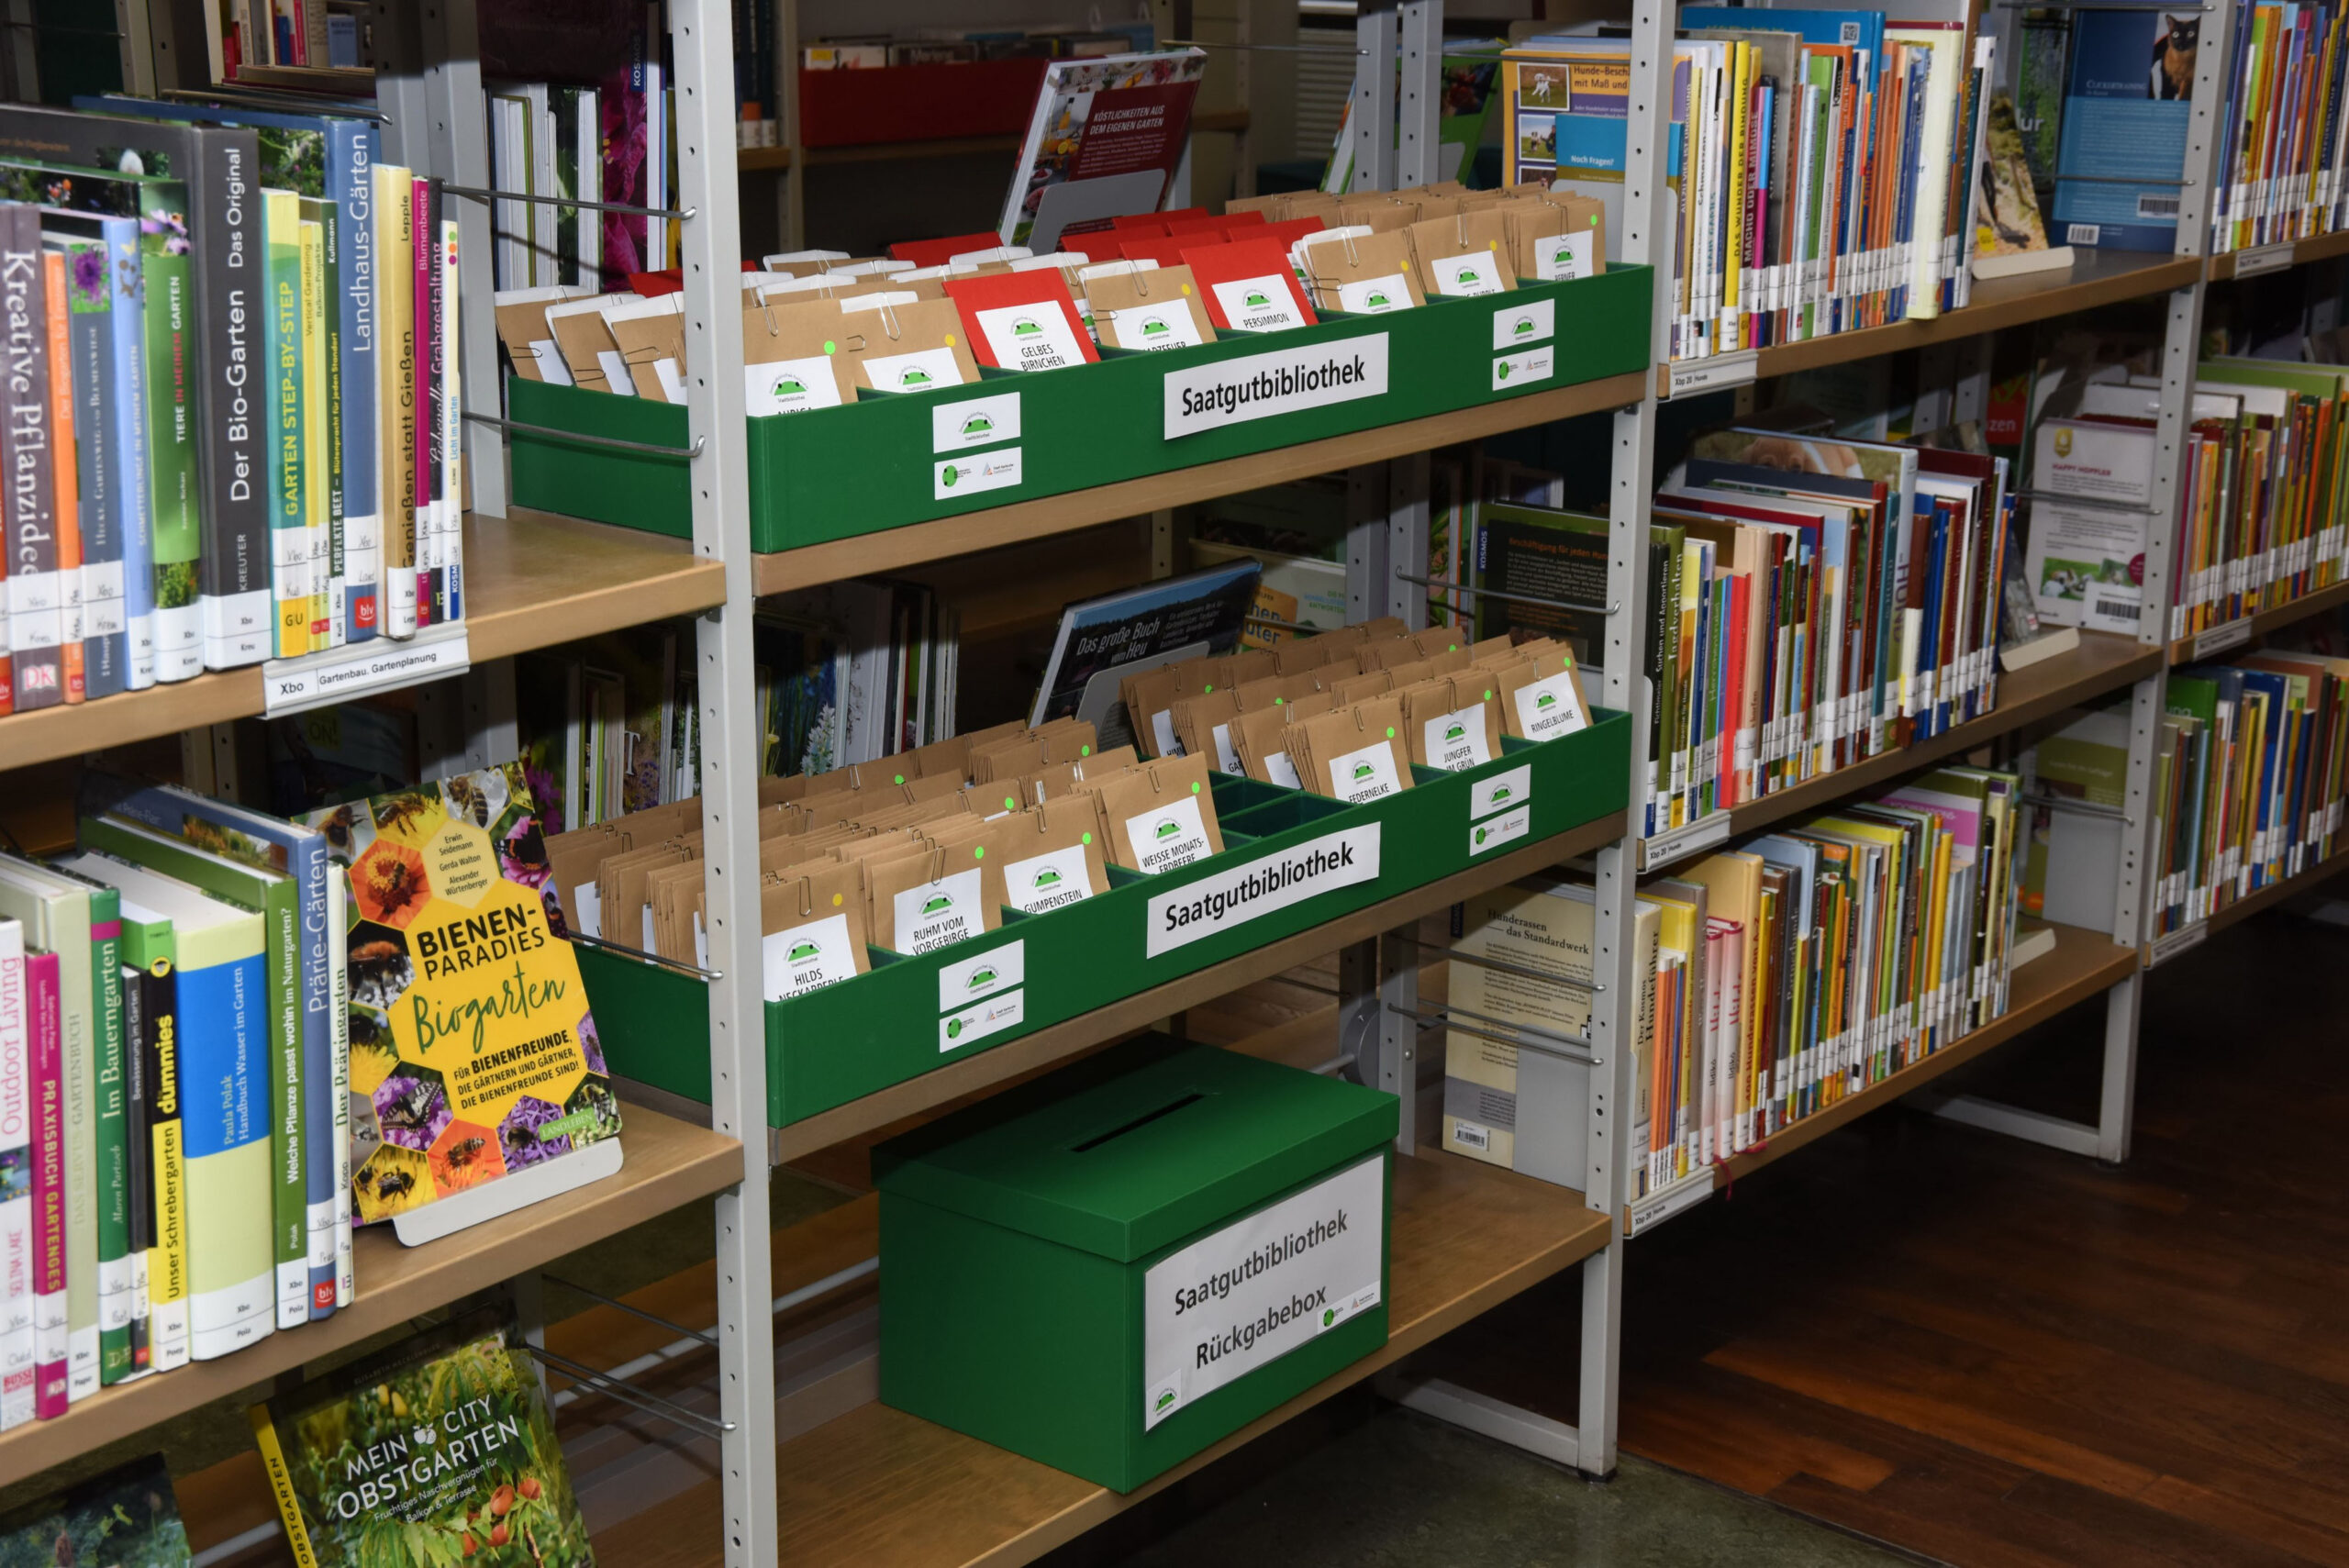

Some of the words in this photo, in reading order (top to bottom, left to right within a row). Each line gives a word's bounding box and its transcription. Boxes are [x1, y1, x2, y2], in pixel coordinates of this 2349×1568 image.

[632, 34, 641, 87] KOSMOS
[1573, 65, 1630, 76] Hunde-Besch
[1574, 80, 1588, 88] mit
[1590, 79, 1609, 89] Maß
[1612, 81, 1628, 90] und
[1089, 124, 1107, 136] DEM
[1106, 121, 1137, 133] EIGENEN
[1136, 117, 1164, 130] GARTEN
[1093, 106, 1150, 123] KÖSTLICHKEITEN
[1150, 105, 1165, 116] AUS
[1571, 154, 1588, 164] Noch
[1588, 156, 1615, 167] Fragen?
[1748, 111, 1759, 168] MIMOSE
[226, 148, 246, 226] Original
[1735, 172, 1744, 228] WUNDER
[1746, 172, 1756, 208] ODER
[401, 195, 410, 241] Lepple
[418, 189, 428, 272] Blumenbeete
[1743, 212, 1754, 262] MACHO
[229, 231, 244, 268] Das
[328, 217, 336, 264] Kullmann
[350, 134, 371, 352] Landhaus-Gärten
[1733, 232, 1742, 257] DAS
[305, 243, 313, 296] Gardening
[3, 249, 40, 395] Kreative
[172, 276, 182, 330] GARTEN
[305, 298, 313, 337] Vertical
[1242, 312, 1290, 330] PERSIMMON
[173, 332, 183, 387] MEINEM
[227, 290, 250, 441] Bio-Garten
[279, 281, 296, 428] STEP-BY-STEP
[400, 329, 412, 408] Gießen
[1020, 355, 1066, 372] BIRNCHEN
[1021, 343, 1054, 358] GELBES
[174, 387, 183, 404] IN
[1182, 354, 1365, 417] Saatgutbibliothek
[176, 405, 186, 443] TIERE
[402, 415, 414, 459] statt
[230, 450, 250, 501] Der
[284, 433, 297, 516] GARTEN
[239, 533, 249, 592] KREUTER
[1479, 529, 1487, 570] KOSMOS
[1075, 637, 1097, 657] Das
[1097, 625, 1131, 653] große
[1131, 617, 1161, 639] Buch
[1657, 617, 1665, 637] und
[280, 682, 304, 695] Xbo
[371, 651, 437, 675] Gartenplanung
[1110, 652, 1127, 665] vom
[1126, 641, 1147, 660] Heu
[1655, 639, 1665, 673] Suchen
[25, 664, 56, 691] DK
[1531, 709, 1575, 734] RINGELBLUME
[1443, 745, 1473, 764] JUNGFER
[1348, 783, 1390, 805] FEDERNELKE
[439, 840, 473, 857] Seidemann
[444, 832, 463, 844] Erwin
[1141, 849, 1170, 868] WEISSE
[1171, 839, 1205, 858] MONATS-
[439, 861, 459, 873] Gerda
[458, 854, 482, 866] Walton
[449, 870, 480, 885] Alexander
[445, 878, 488, 896] Würtenberger
[1023, 889, 1083, 914] GUMPENSTEIN
[1165, 840, 1354, 932] Saatgutbibliothek
[306, 848, 328, 1013] Prärie-Gärten
[417, 903, 538, 960] BIENEN-
[912, 928, 970, 956] VORGEBIRGE
[913, 922, 941, 942] RUHM
[941, 916, 964, 934] VOM
[1487, 908, 1548, 932] Hunderassen
[1506, 926, 1521, 938] das
[1523, 930, 1589, 955] Standardwerk
[281, 907, 296, 986] Naturgarten?
[424, 926, 546, 982] PARADIES
[0, 955, 23, 1033] Living
[233, 967, 244, 1014] Garten
[283, 988, 295, 1005] im
[794, 968, 823, 986] HILDS
[1645, 930, 1660, 1041] Hundeführer
[100, 940, 122, 1085] Bauerngarten
[234, 1014, 245, 1030] im
[412, 961, 566, 1055] Biogarten
[1638, 979, 1648, 1022] Kosmos
[284, 1006, 296, 1046] wohin
[334, 968, 348, 1085] Präriegarten
[1637, 1023, 1645, 1046] Der
[1745, 977, 1757, 1081] Hunderassen
[156, 1013, 177, 1115] dummies
[235, 1034, 246, 1073] Wasser
[285, 1048, 299, 1084] passt
[453, 1067, 471, 1081] FÜR
[471, 1029, 573, 1074] BIENENFREUNDE,
[457, 1084, 473, 1096] DIE
[473, 1067, 518, 1091] GÄRTNERN
[519, 1061, 537, 1075] UND
[538, 1047, 577, 1068] GÄRTNER,
[1, 1038, 23, 1136] Outdoor
[103, 1088, 121, 1118] Im
[221, 1075, 233, 1109] Polak
[236, 1074, 249, 1140] Handbuch
[461, 1097, 477, 1110] DIE
[479, 1069, 554, 1104] BIENENFREUNDE
[555, 1061, 580, 1078] SIND!
[223, 1110, 235, 1145] Paula
[285, 1085, 298, 1134] Pflanze
[335, 1093, 349, 1127] Der
[541, 1113, 593, 1138] LANDLEBEN
[42, 1079, 59, 1186] PRAXISBUCH
[286, 1136, 299, 1184] Welche
[163, 1127, 179, 1249] Schrebergarten
[290, 1223, 298, 1250] Polak
[168, 1251, 181, 1299] Unser
[1174, 1209, 1348, 1316] Saatgutbibliothek
[1196, 1285, 1327, 1370] Rückgabebox
[346, 1433, 408, 1482] MEIN
[443, 1394, 493, 1434] CITY
[338, 1414, 520, 1520] OBSTGARTEN
[269, 1456, 310, 1565] OBSTGARTEN
[373, 1496, 418, 1523] Fruchtiges
[418, 1467, 485, 1503] Naschvergnügen
[484, 1456, 498, 1473] für
[406, 1503, 435, 1524] Balkon
[435, 1497, 444, 1510] &
[443, 1483, 477, 1507] Terrasse
